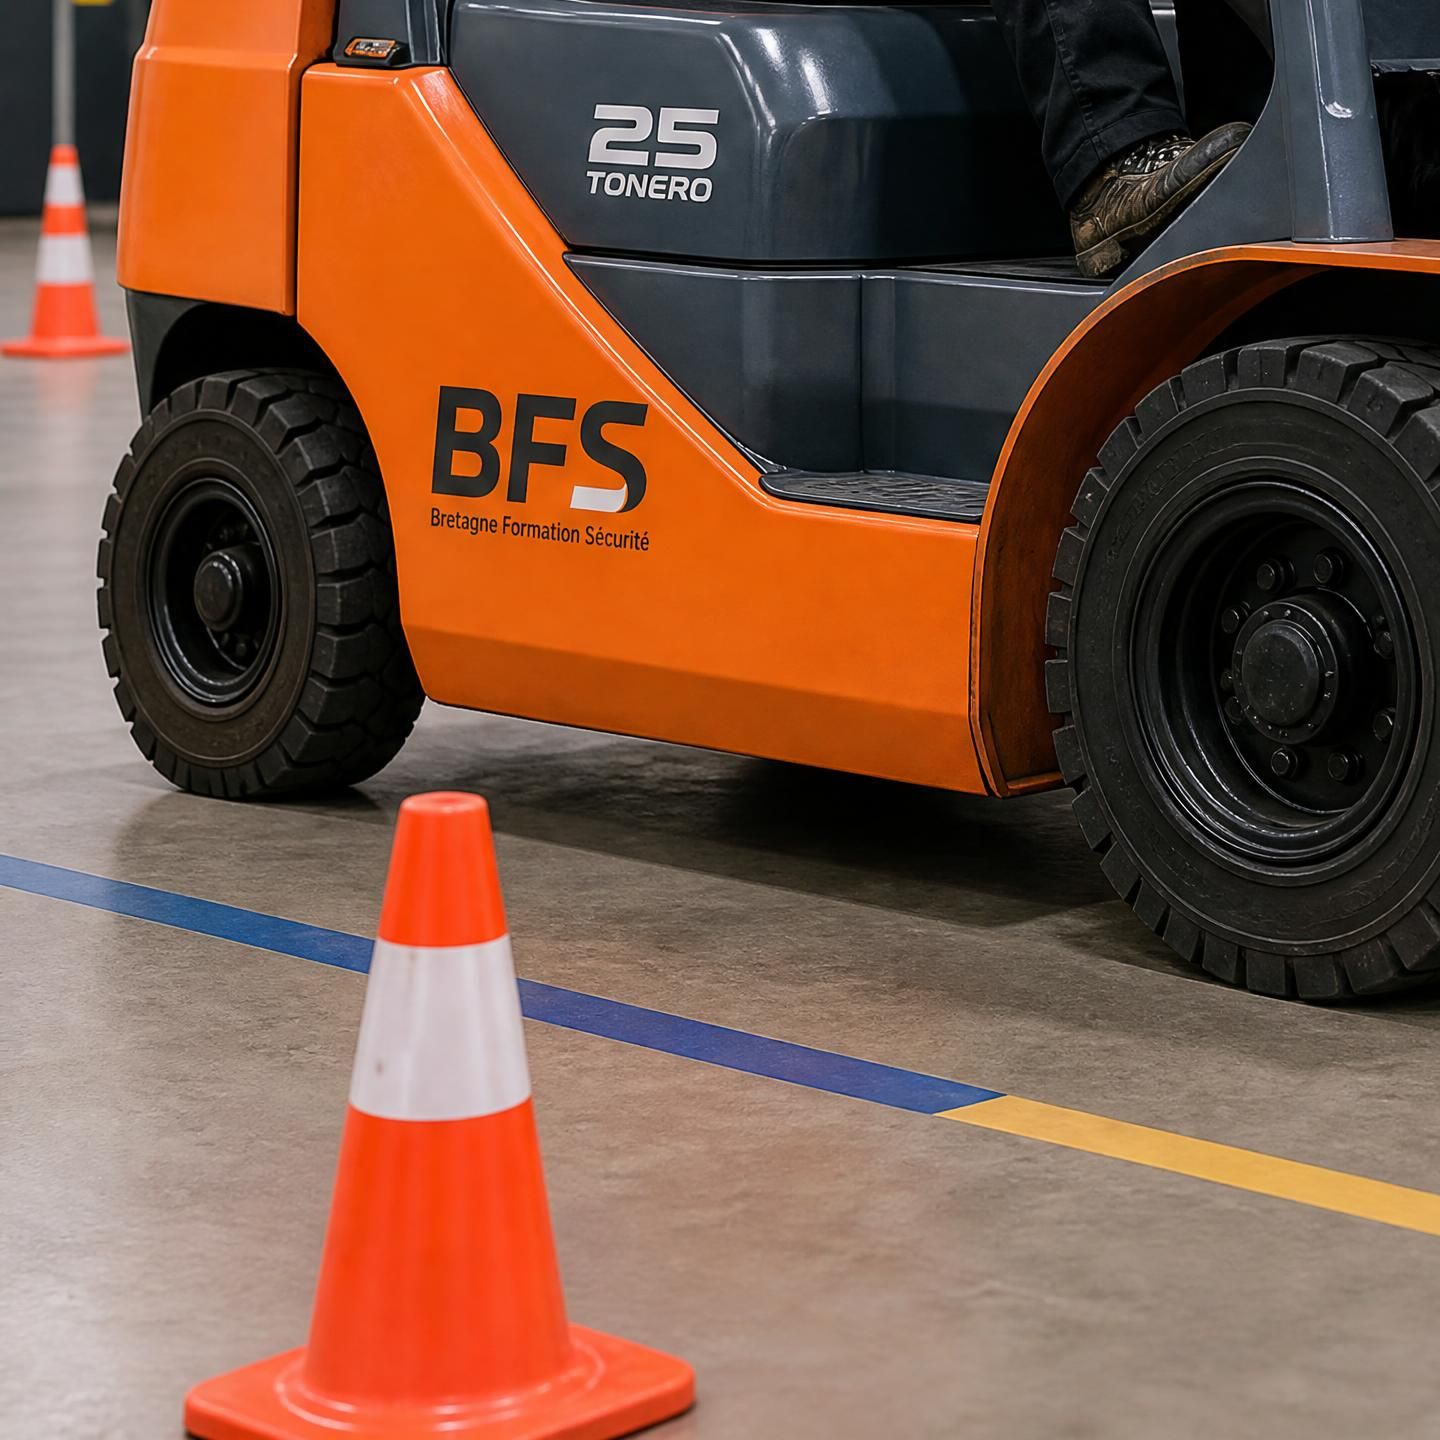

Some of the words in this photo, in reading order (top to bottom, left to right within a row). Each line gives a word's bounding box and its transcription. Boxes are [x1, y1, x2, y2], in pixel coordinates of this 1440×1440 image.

[588, 104, 720, 170] 25
[586, 171, 713, 203] TONERO
[431, 385, 649, 514] BFS
[431, 508, 497, 535] Bretagne
[503, 516, 580, 543] Formation
[585, 525, 650, 552] Sécurité
